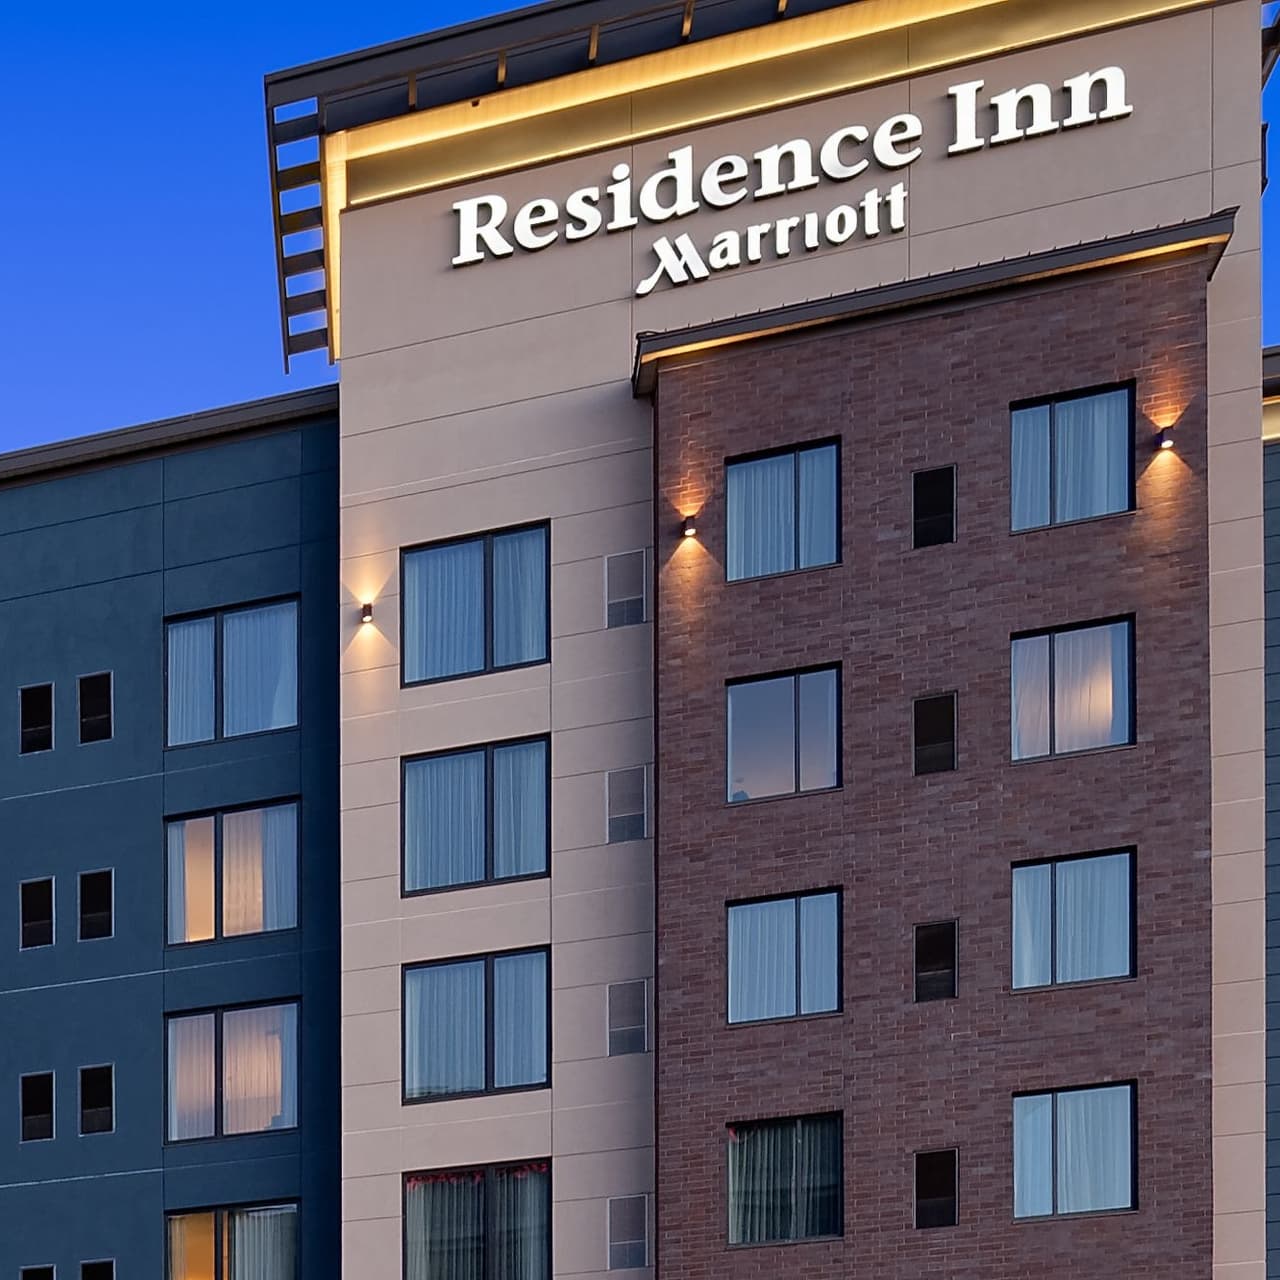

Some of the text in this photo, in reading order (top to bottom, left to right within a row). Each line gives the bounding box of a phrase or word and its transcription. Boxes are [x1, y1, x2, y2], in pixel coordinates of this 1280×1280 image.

[451, 66, 1135, 267] Residence Inn
[635, 180, 910, 296] Marriott
